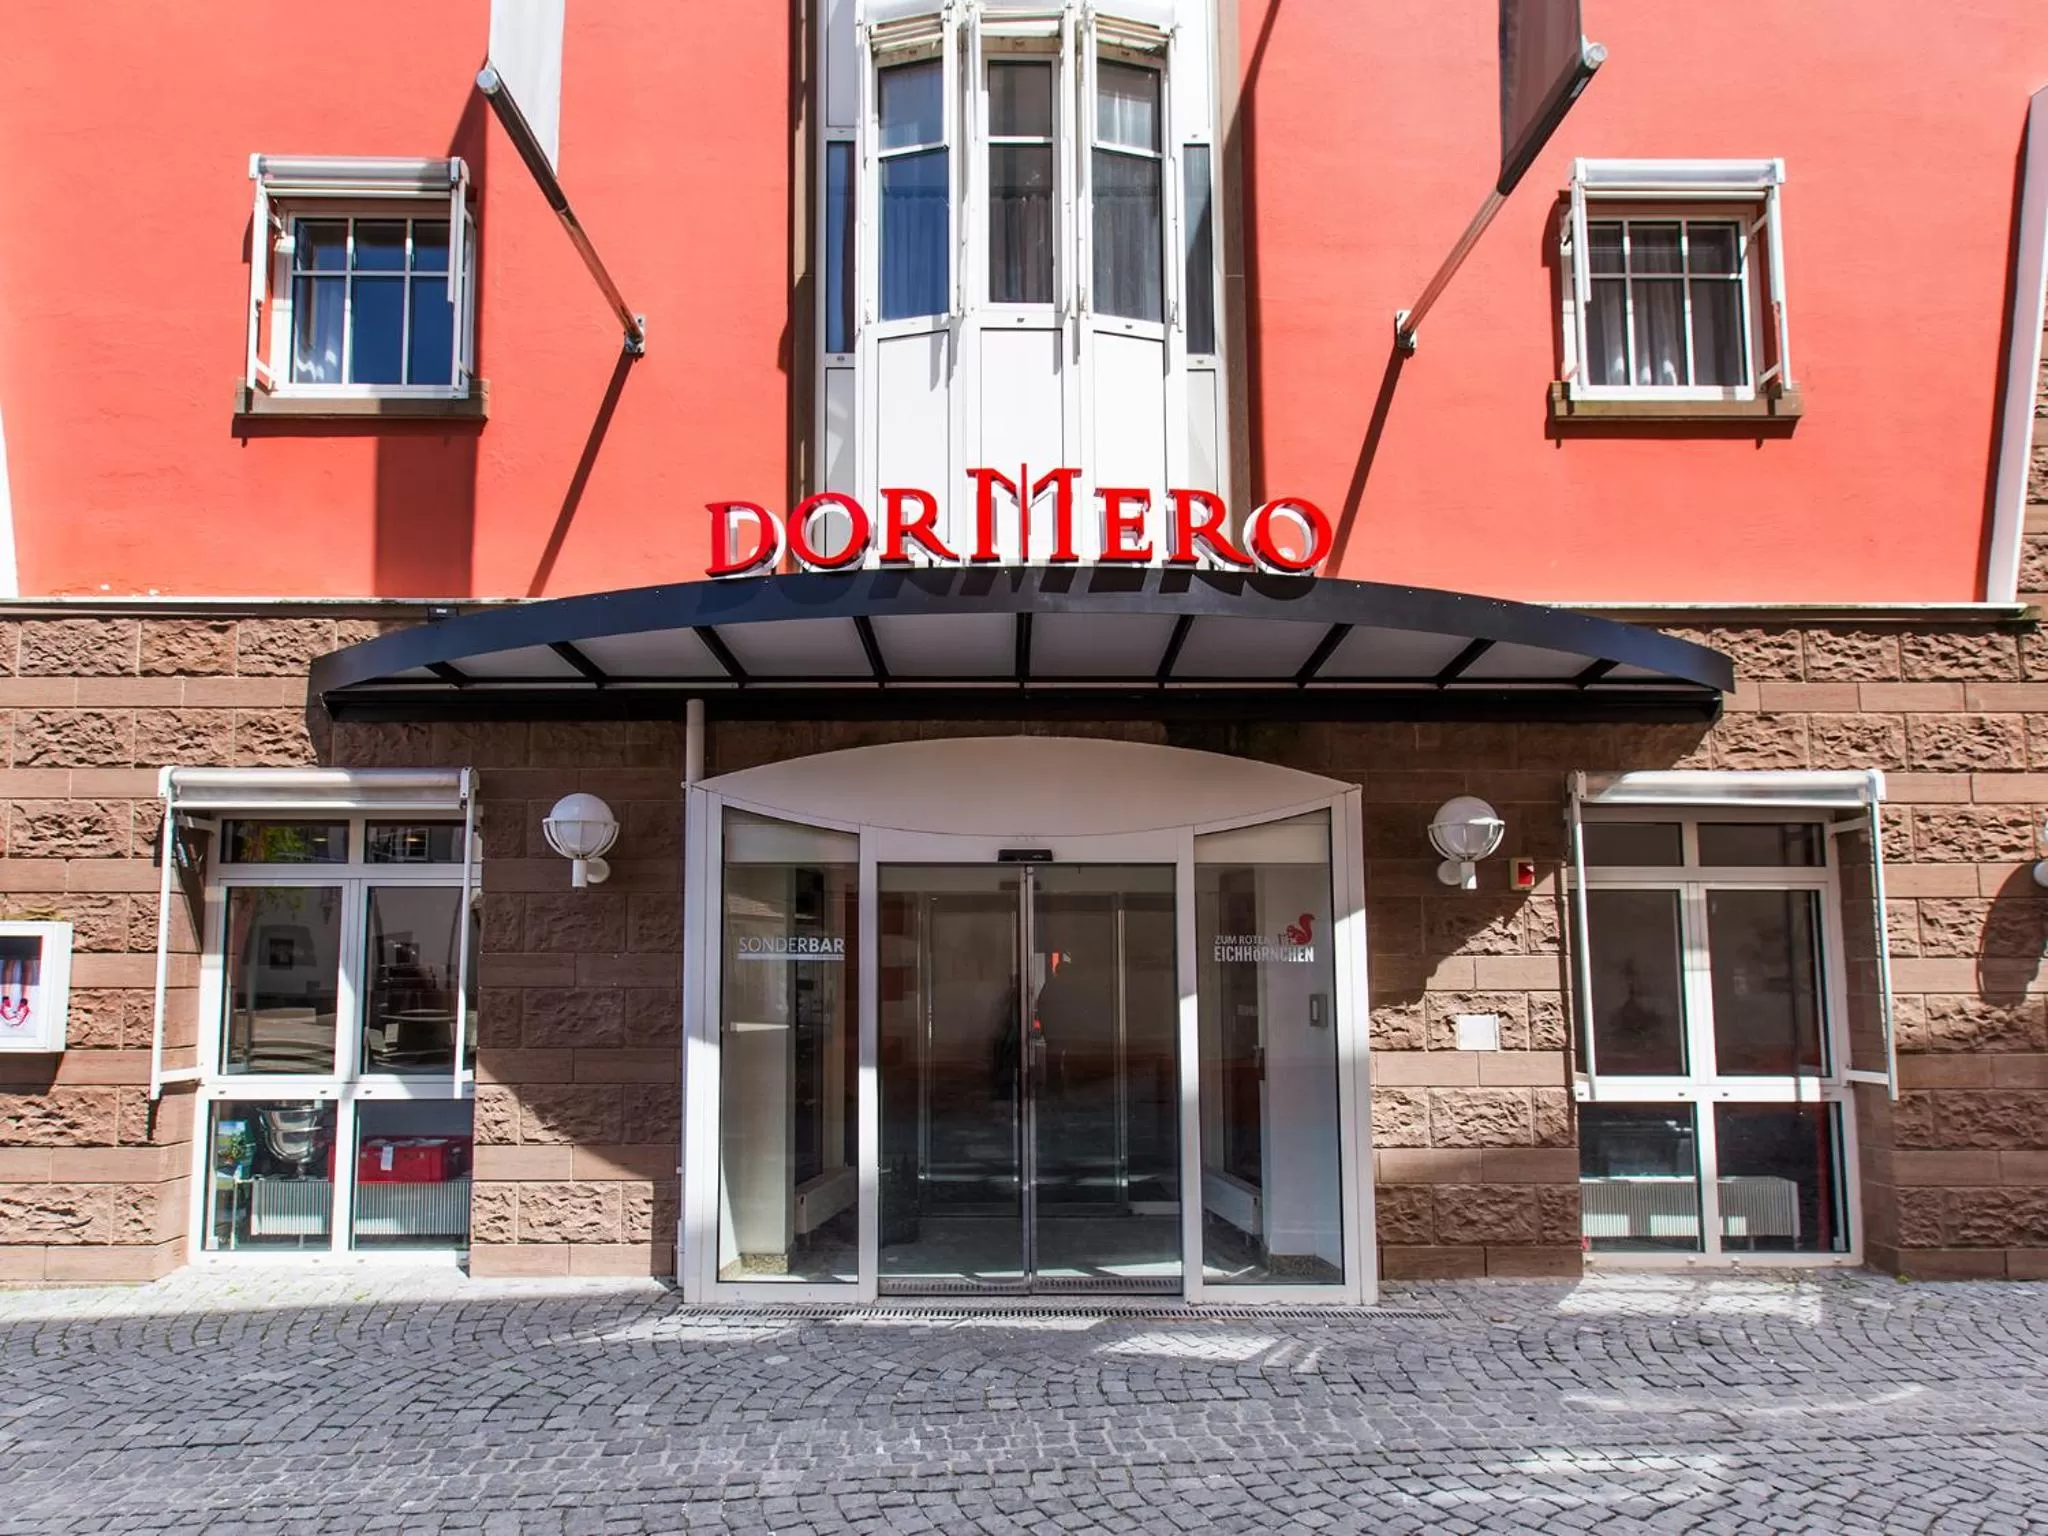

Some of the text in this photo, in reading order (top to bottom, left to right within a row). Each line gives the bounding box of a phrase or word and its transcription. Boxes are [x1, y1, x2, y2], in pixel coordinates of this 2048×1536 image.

[705, 462, 1333, 576] DORMERO
[738, 937, 845, 953] SONDERBAR
[1214, 935, 1237, 945] ZUM
